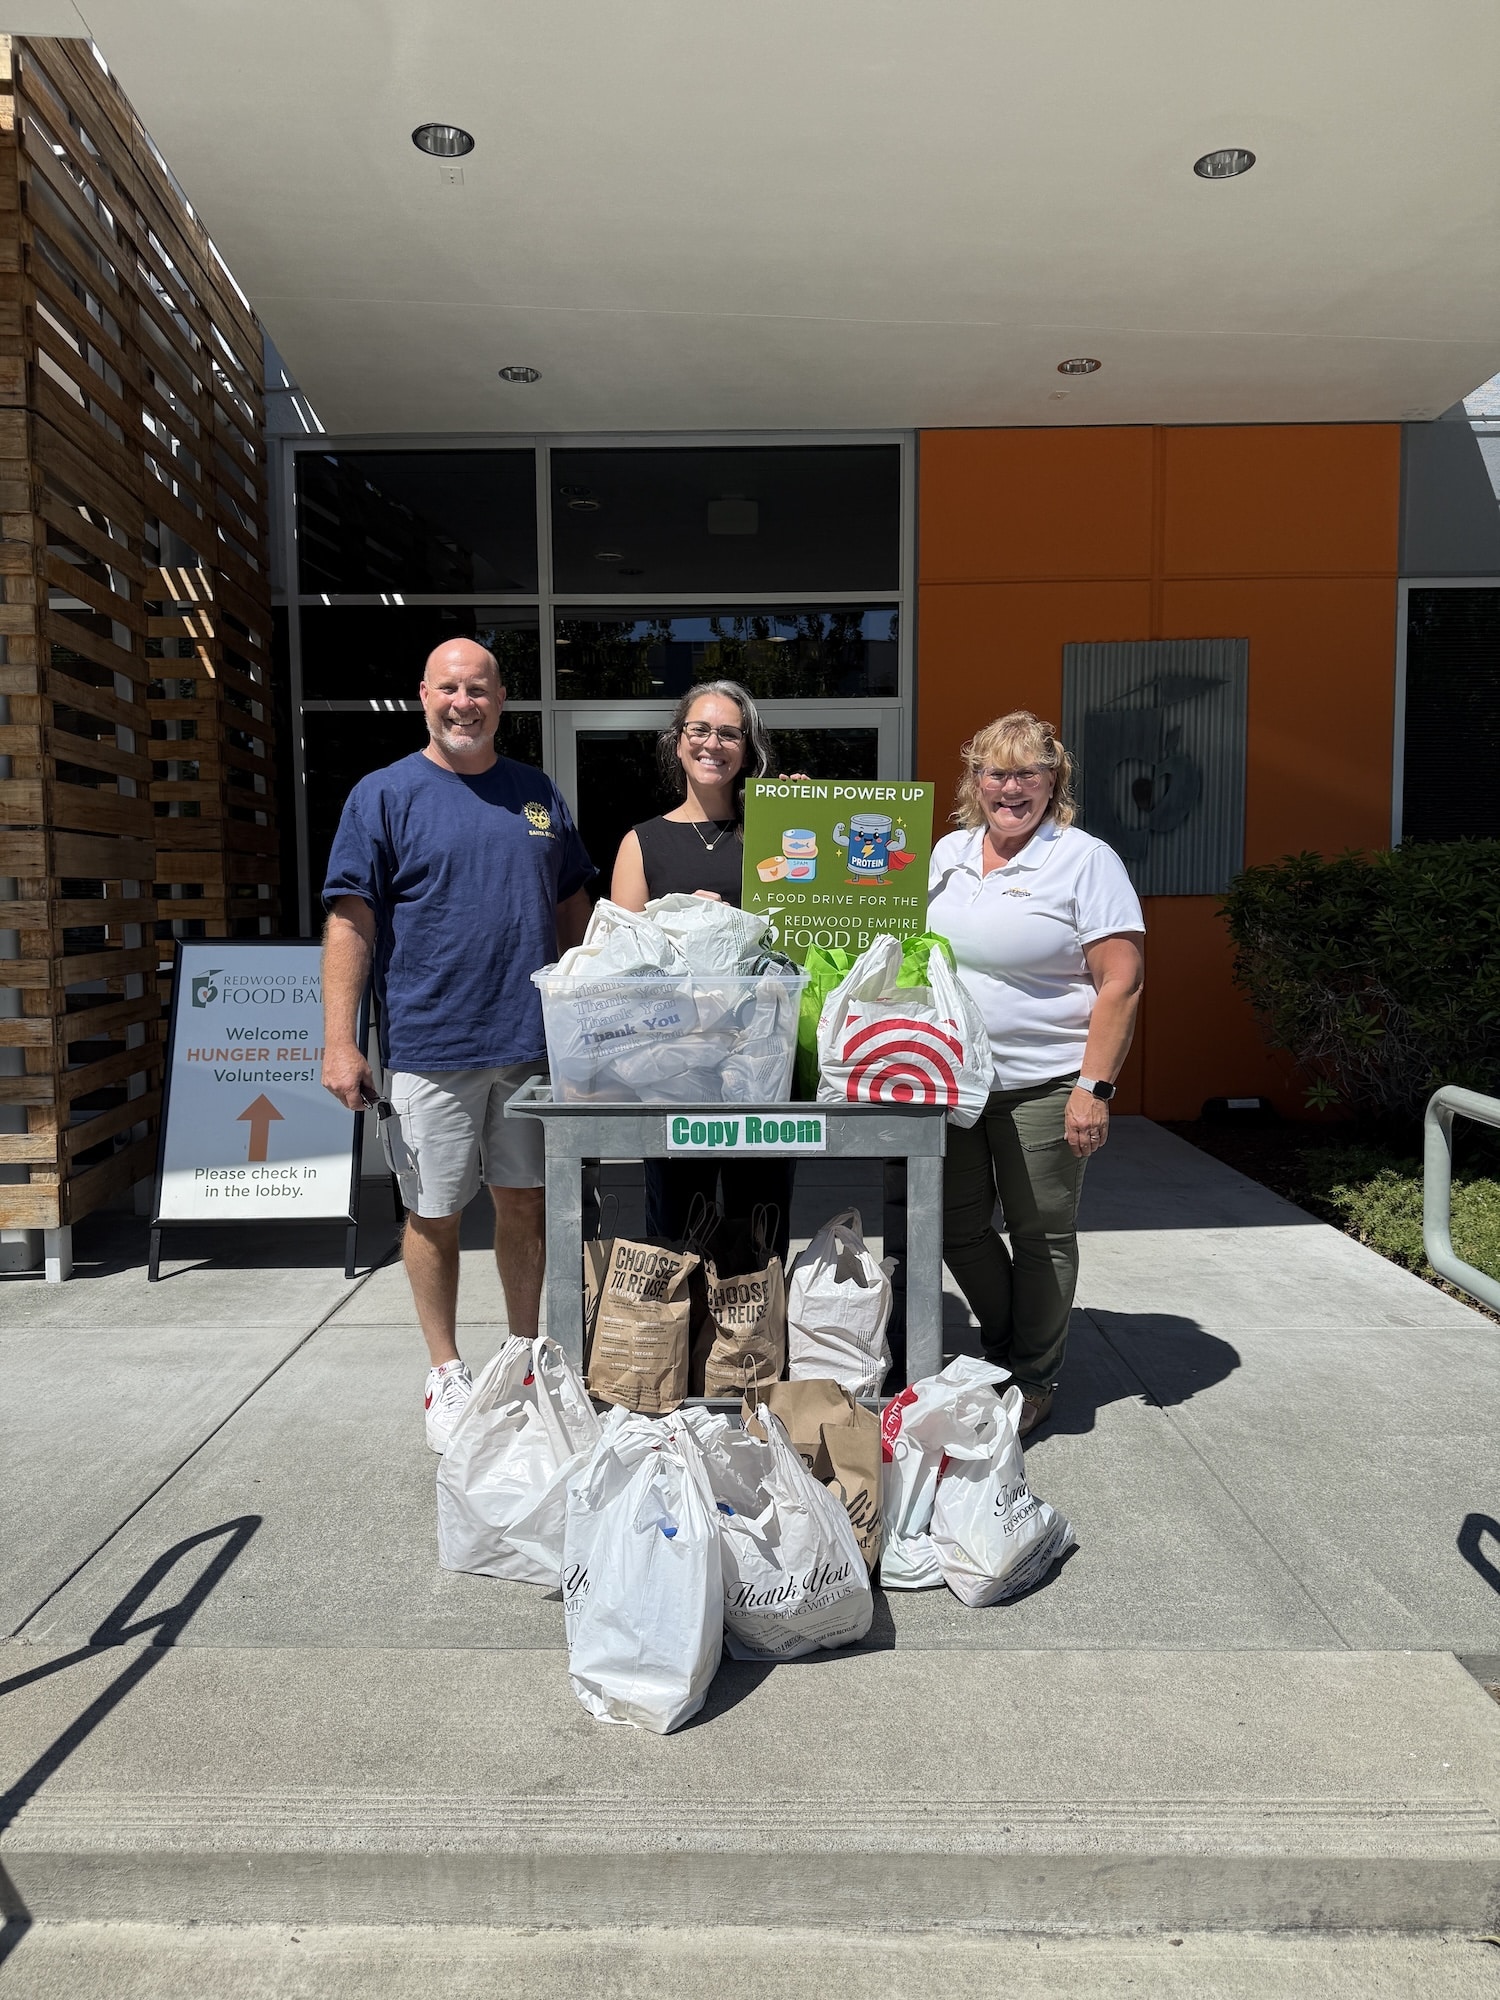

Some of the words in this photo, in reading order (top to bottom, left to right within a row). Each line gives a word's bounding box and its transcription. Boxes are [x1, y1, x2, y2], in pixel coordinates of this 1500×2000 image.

[755, 784, 828, 799] PROTEIN
[833, 786, 897, 801] POWER
[902, 788, 924, 801] UP
[851, 856, 884, 868] PROTEIN
[752, 892, 761, 902] A
[767, 893, 806, 904] FOOD
[812, 895, 853, 905] DRIVE
[859, 895, 887, 905] FOR
[893, 896, 919, 907] THE
[784, 915, 862, 928] REDWOOD
[868, 917, 918, 929] EMPIRE
[784, 929, 851, 949] FOOD
[223, 975, 297, 986] REDWOOD
[222, 988, 286, 1004] FOOD
[573, 992, 630, 1015] Thank
[635, 983, 673, 998] You
[577, 1008, 634, 1031] Thank
[640, 999, 676, 1014] You
[226, 1027, 309, 1041] Welcome
[581, 1023, 638, 1045] Thank
[642, 1014, 680, 1030] You
[187, 1048, 270, 1062] HUNGER
[213, 1069, 315, 1082] Volunteers!
[671, 1117, 739, 1147] Copy
[745, 1117, 822, 1144] Room
[195, 1167, 247, 1180] Please
[250, 1167, 298, 1179] check
[303, 1167, 317, 1179] in
[205, 1185, 219, 1198] in
[224, 1185, 250, 1197] the
[256, 1185, 303, 1199] lobby.
[616, 1246, 682, 1280] CHOOSE
[610, 1271, 626, 1289] TO
[627, 1274, 668, 1298] REUSE
[728, 1303, 768, 1324] REUSE
[727, 1576, 800, 1607] Thank
[802, 1562, 850, 1603] You
[807, 1593, 836, 1611] WITH
[838, 1587, 853, 1600] US.
